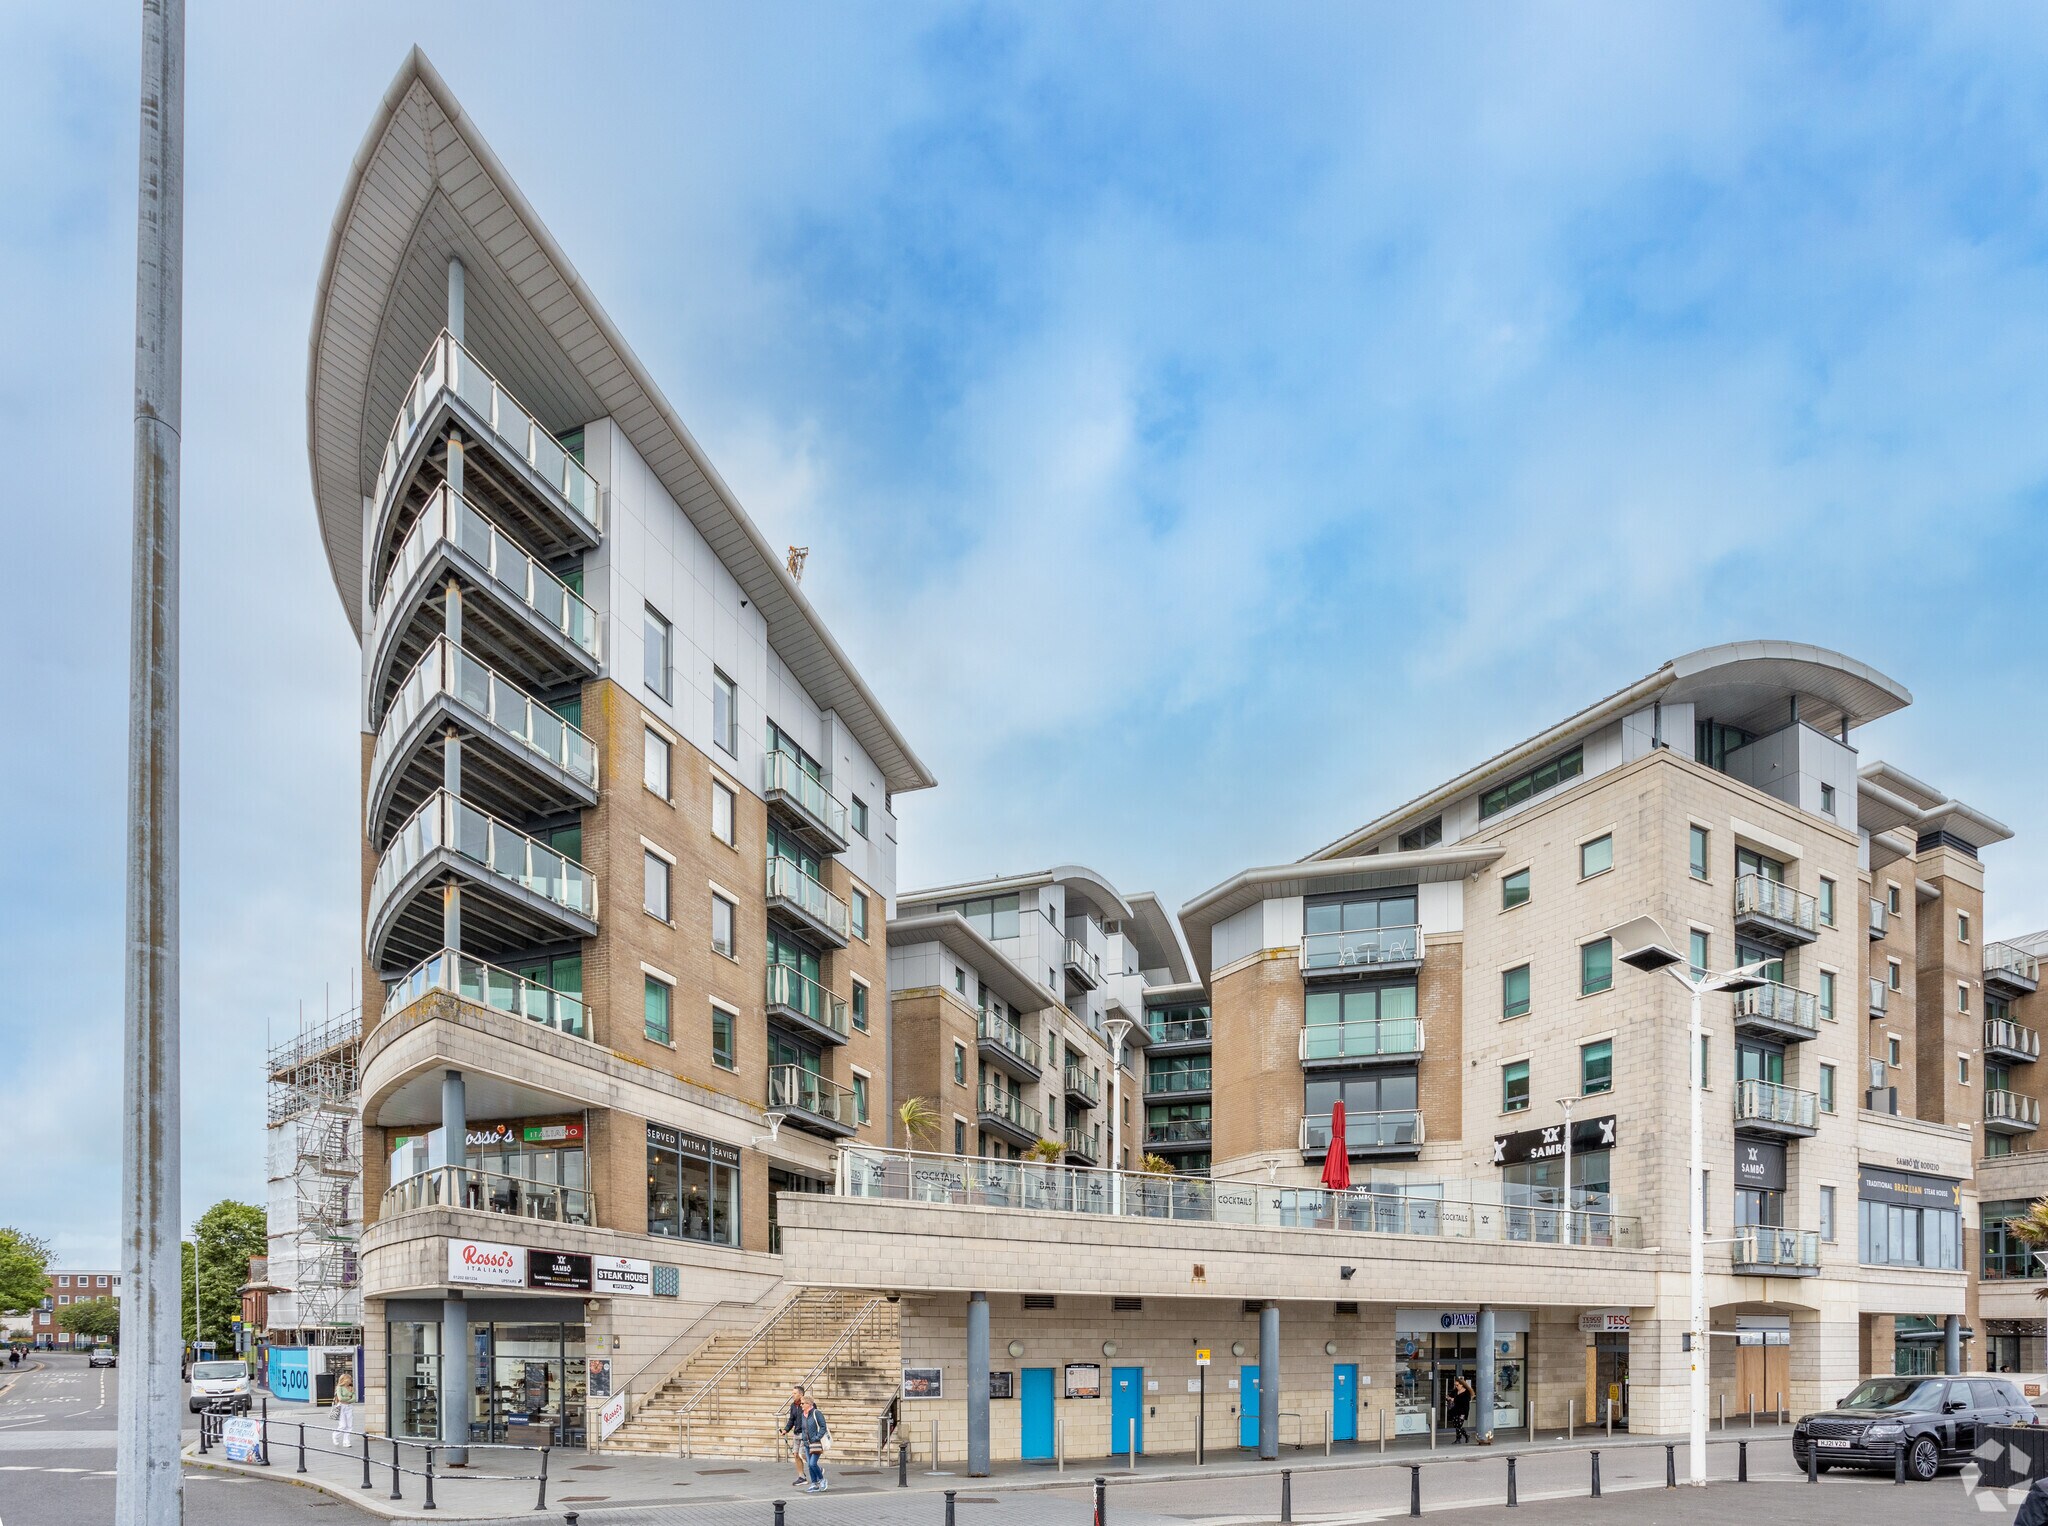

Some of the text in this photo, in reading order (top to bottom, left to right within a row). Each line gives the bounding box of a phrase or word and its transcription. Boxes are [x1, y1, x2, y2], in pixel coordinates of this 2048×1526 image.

[465, 1125, 515, 1146] osso's
[530, 1128, 578, 1138] ITALIANO
[647, 1129, 675, 1144] SERVED
[682, 1138, 700, 1150] WITH
[701, 1144, 707, 1153] A
[914, 1170, 961, 1183] COCKTAILS
[1039, 1181, 1057, 1192] BAR
[1866, 1179, 1948, 1198] TRADITIONAL BRAZILIAN STEAK HOUSE
[1135, 1188, 1158, 1199] GRILL
[1218, 1195, 1253, 1206] COCKTAILS
[1309, 1203, 1323, 1212] BAR
[1442, 1212, 1468, 1222] COCKTAILS
[462, 1245, 513, 1268] Rosso's
[467, 1265, 510, 1274] ITALIANO
[598, 1270, 648, 1283] STEAK HOUSE
[1451, 1313, 1477, 1326] PAVE
[1582, 1316, 1602, 1324] TESCO
[1606, 1315, 1630, 1325] TESC
[603, 1404, 623, 1424] Rosso's
